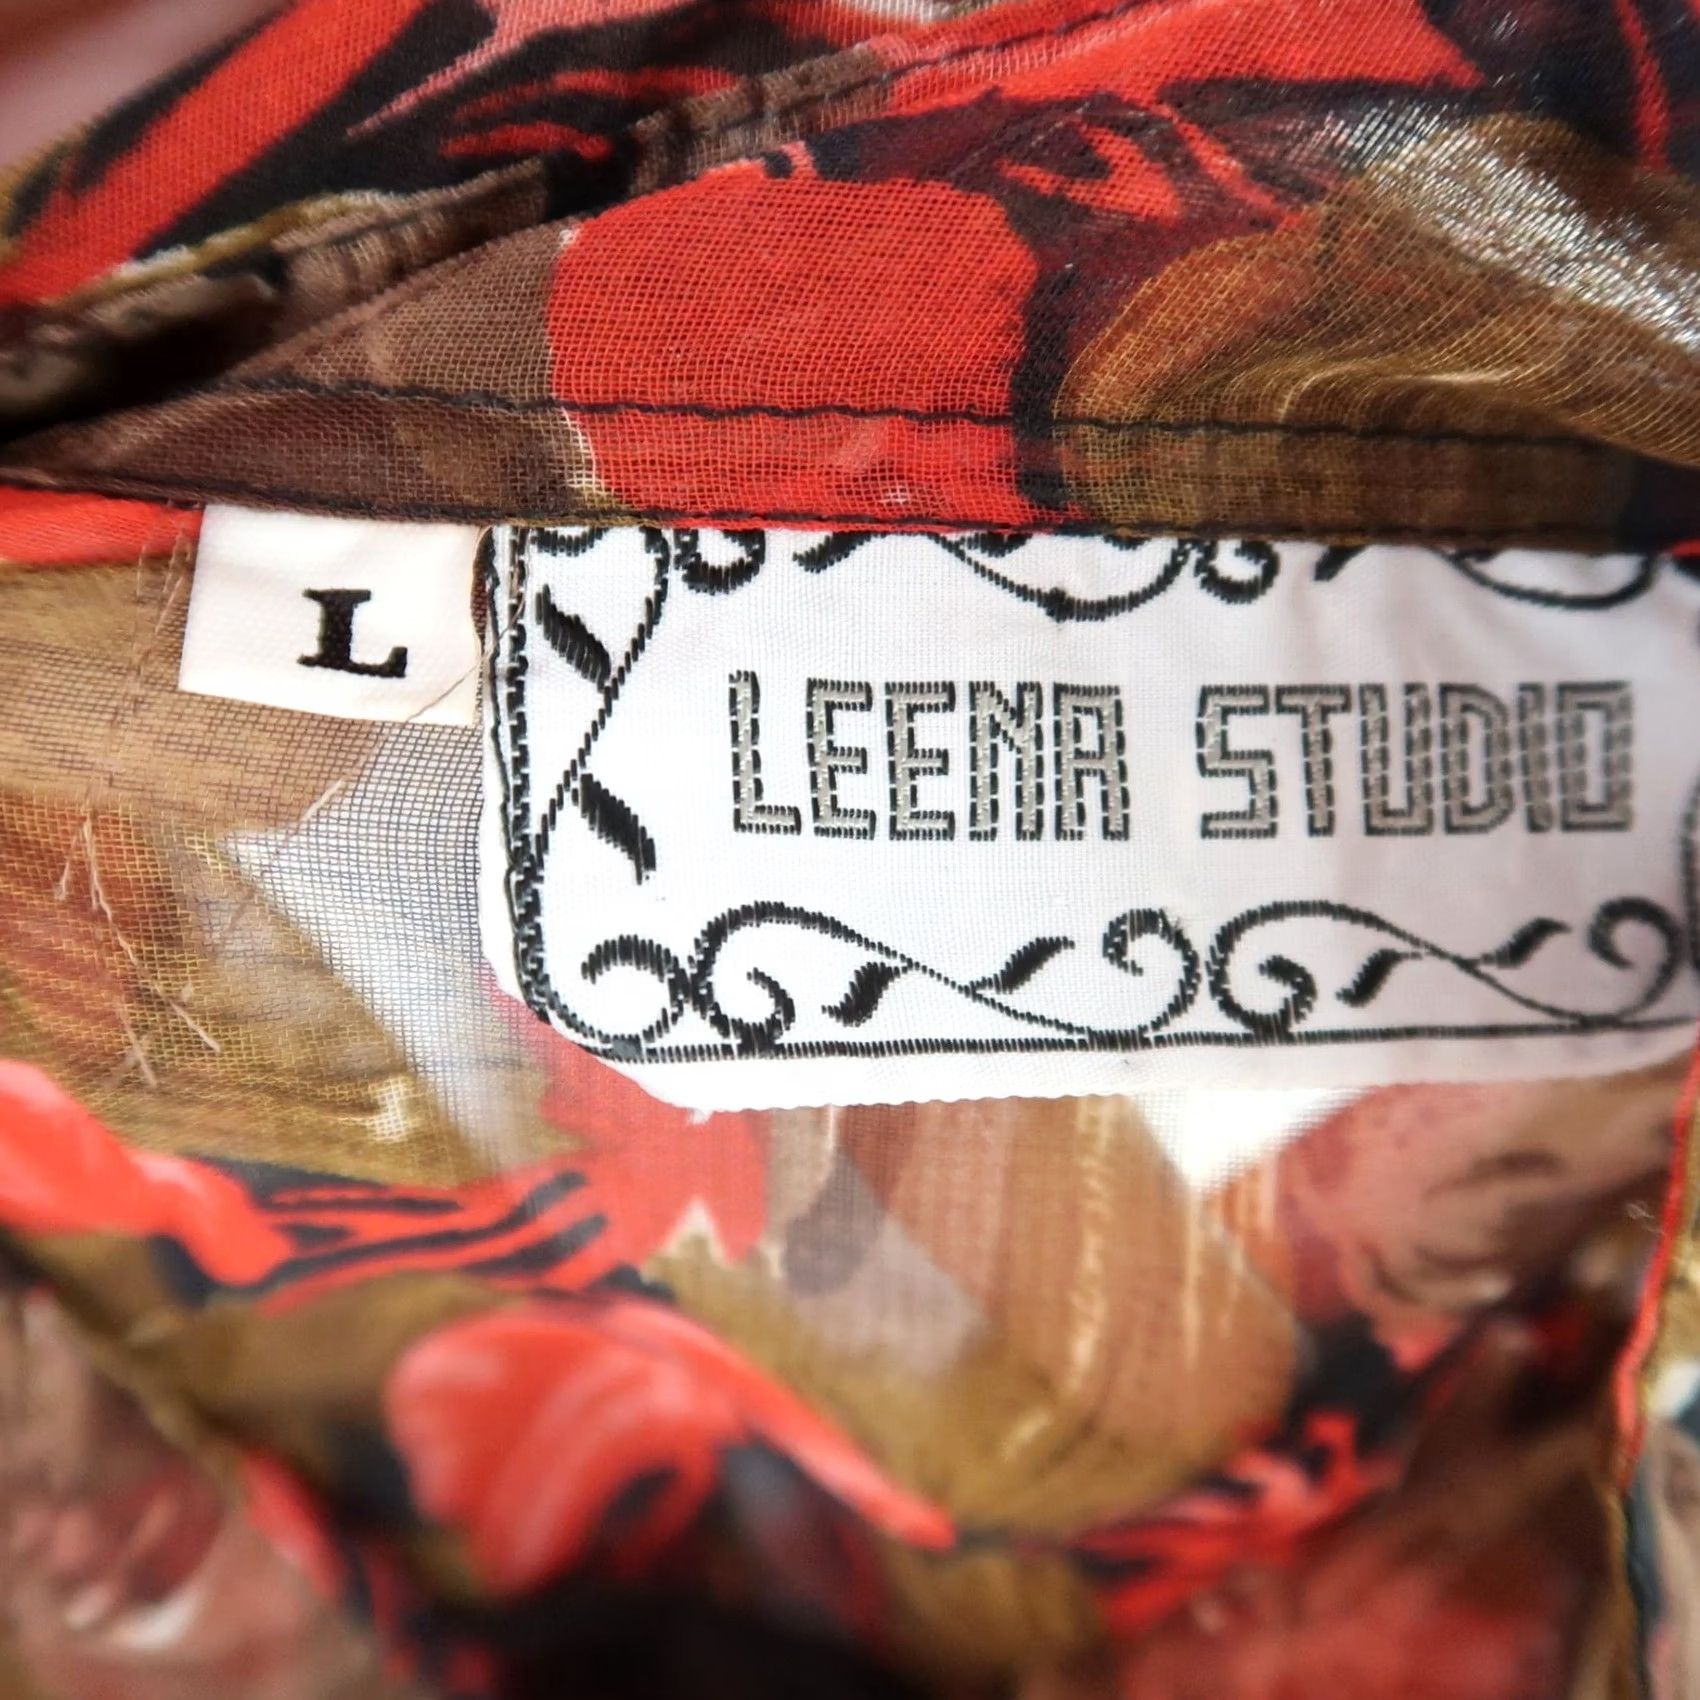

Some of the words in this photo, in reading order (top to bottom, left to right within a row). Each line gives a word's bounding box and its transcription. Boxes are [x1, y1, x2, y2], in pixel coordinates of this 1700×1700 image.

[298, 588, 408, 679] L
[728, 670, 1130, 841] LEENA
[1195, 681, 1633, 839] STUDIO
